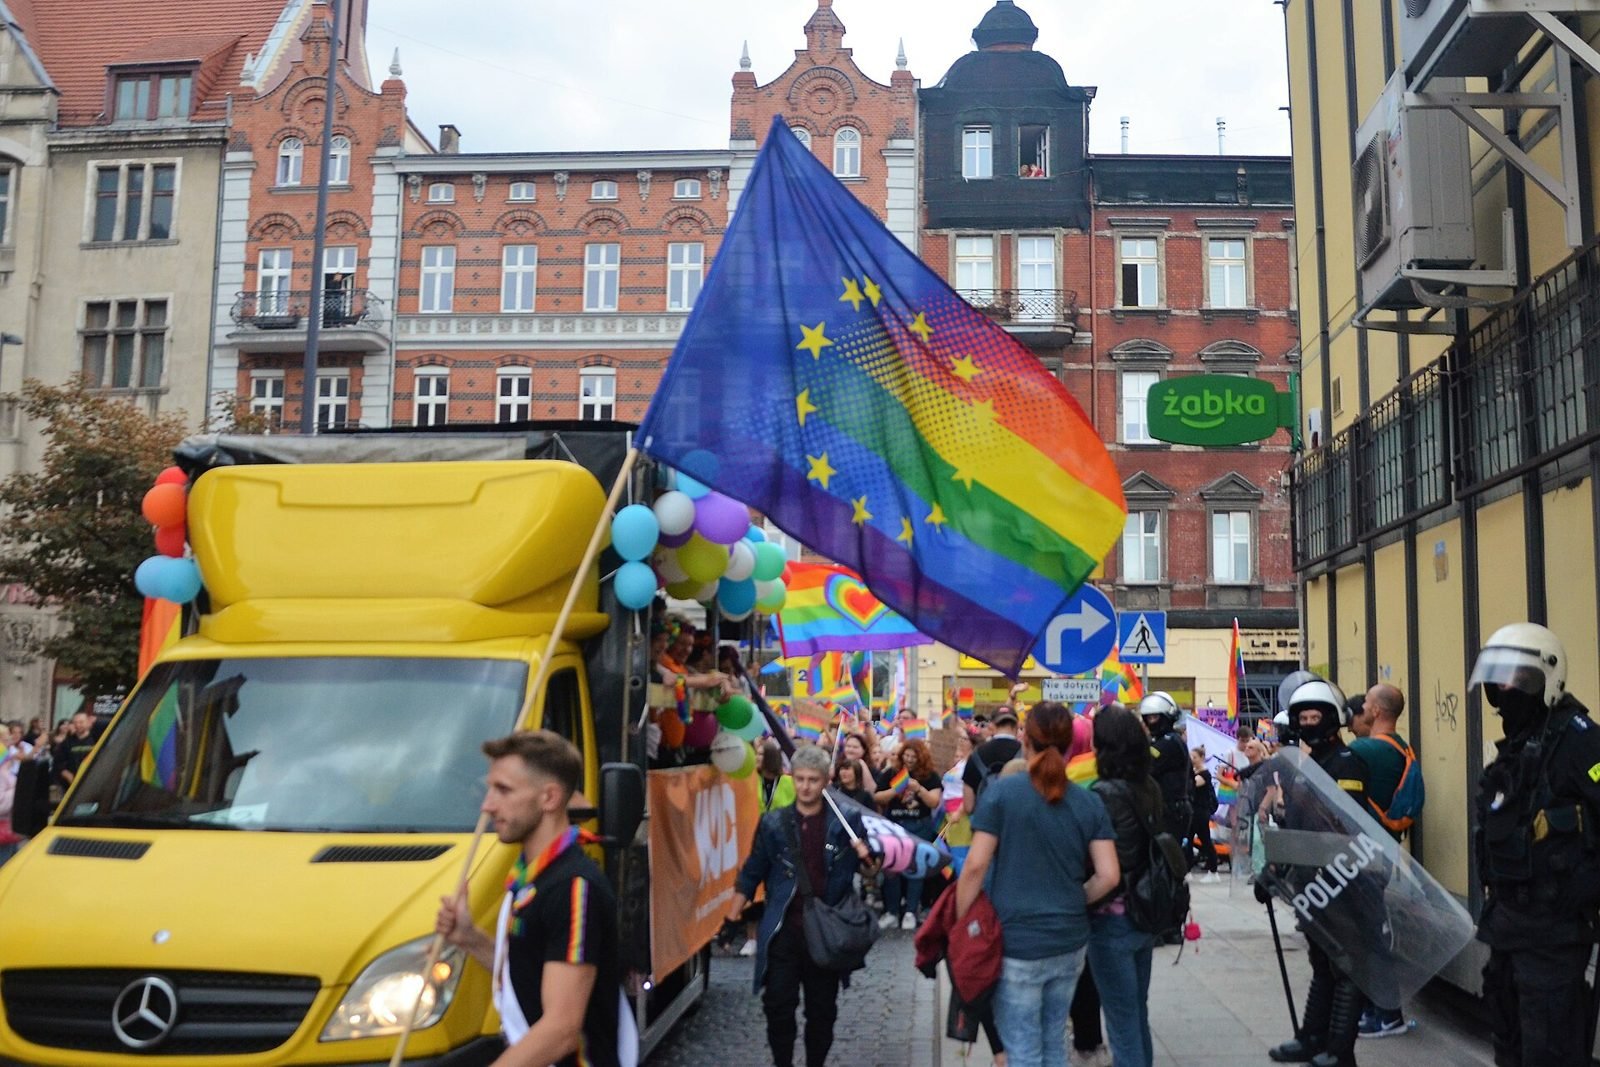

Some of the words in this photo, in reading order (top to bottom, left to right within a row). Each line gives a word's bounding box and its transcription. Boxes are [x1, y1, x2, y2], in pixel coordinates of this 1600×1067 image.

[1163, 388, 1265, 416] żabka
[1044, 680, 1059, 689] Nie
[1064, 680, 1099, 691] dotyczy
[1292, 831, 1384, 922] POLICJA
